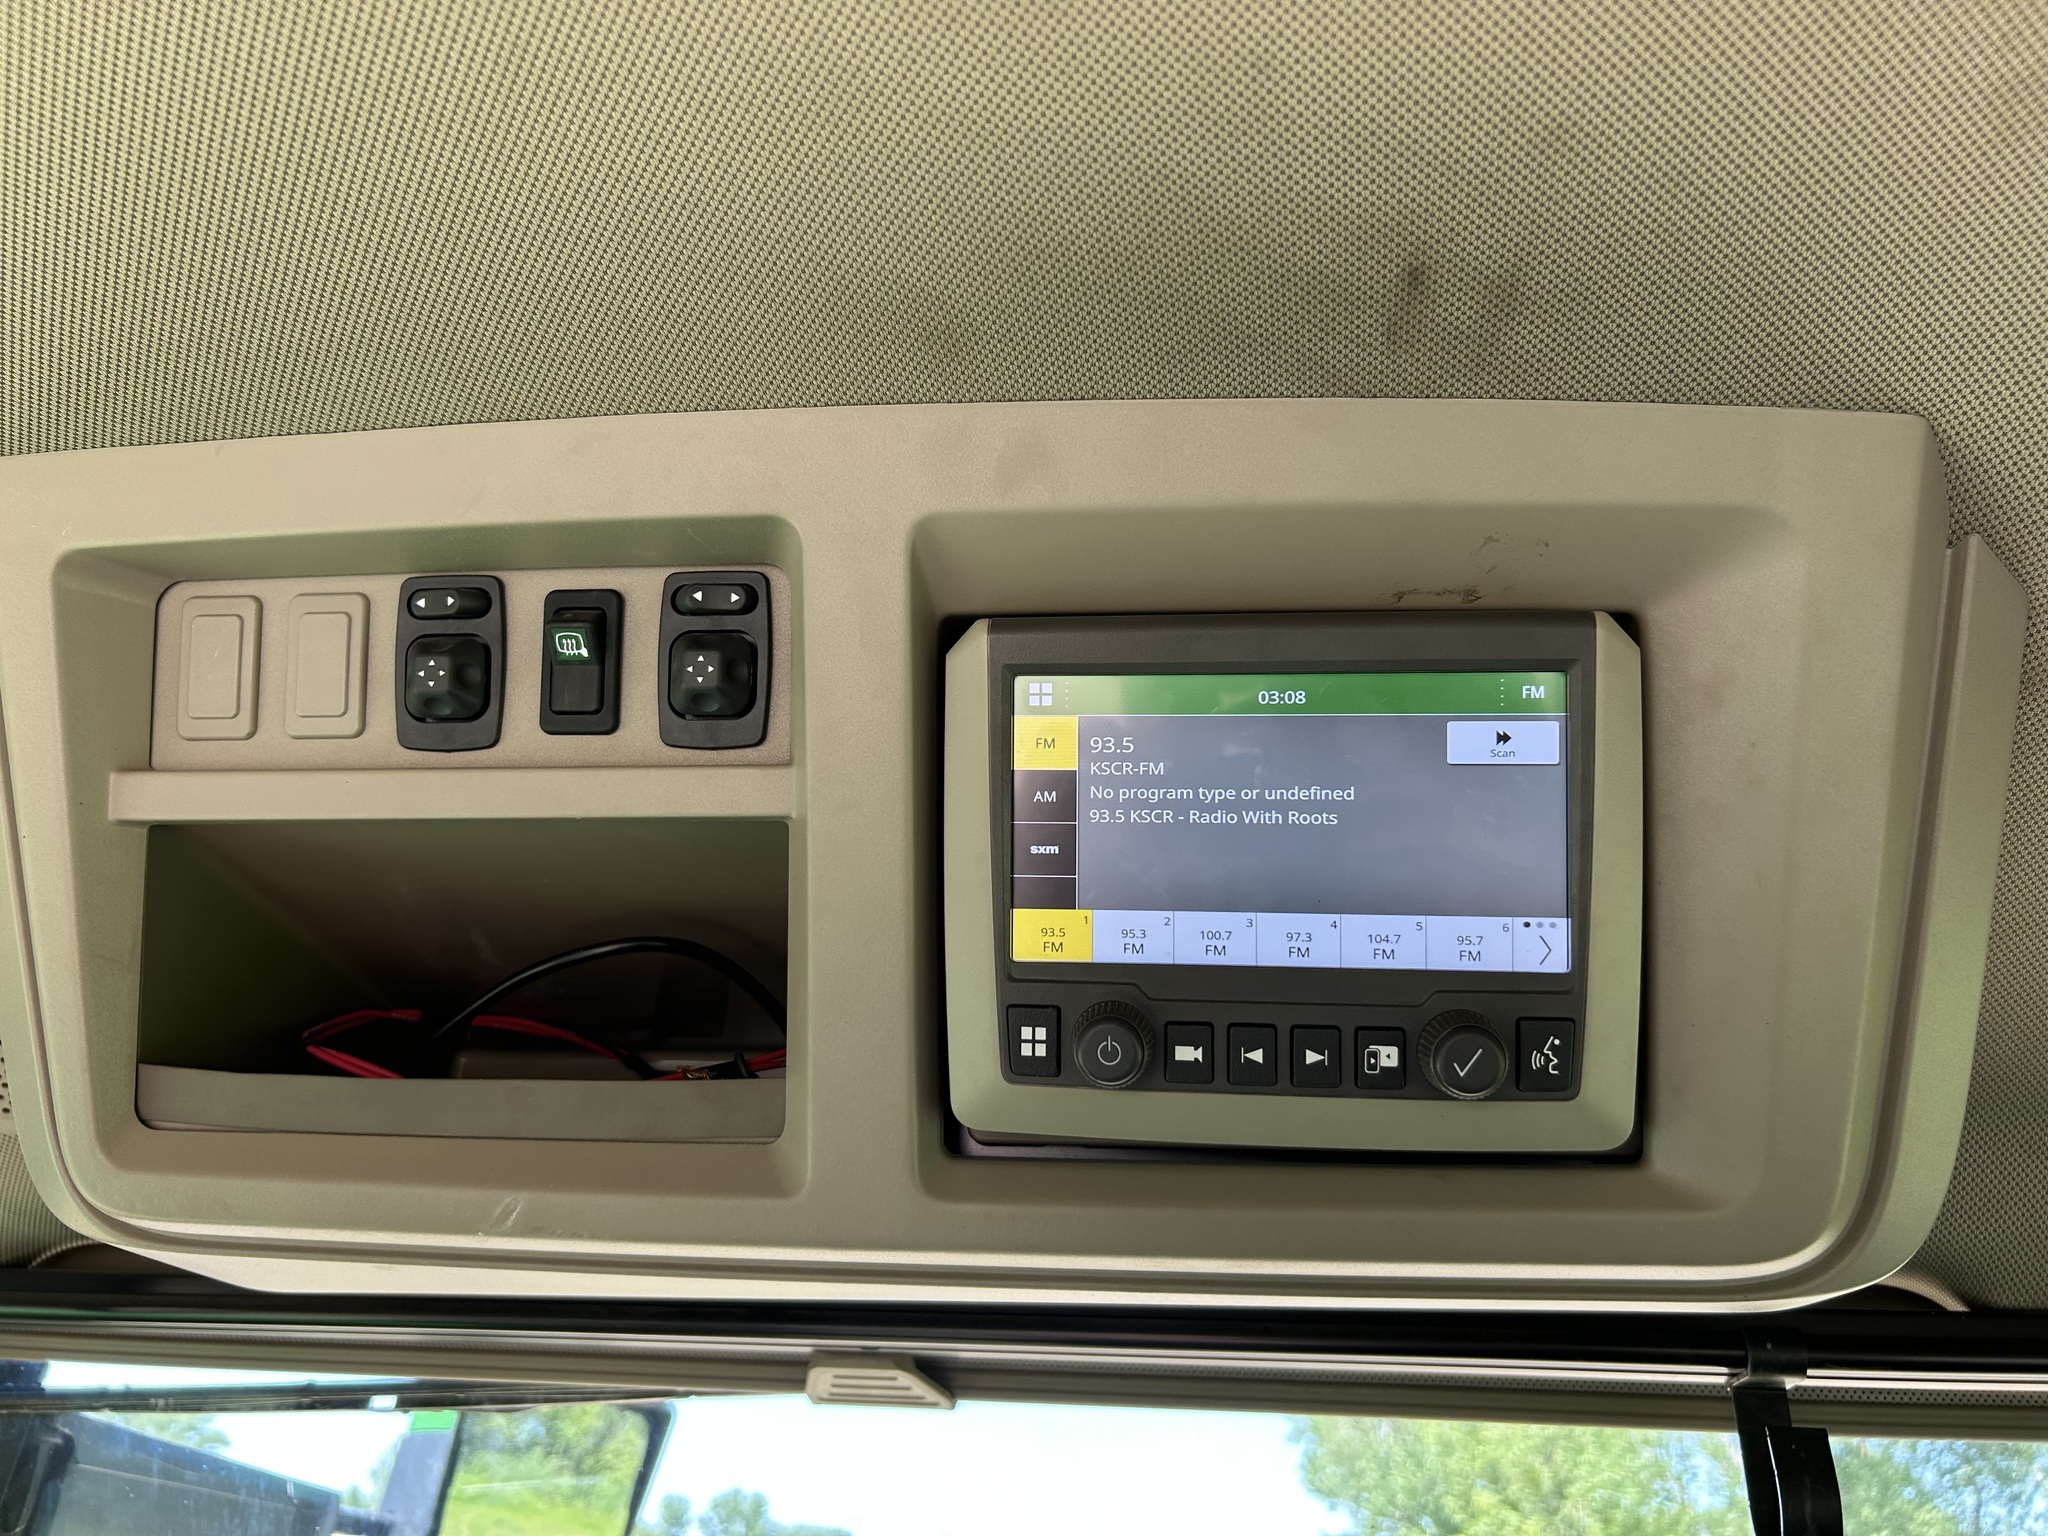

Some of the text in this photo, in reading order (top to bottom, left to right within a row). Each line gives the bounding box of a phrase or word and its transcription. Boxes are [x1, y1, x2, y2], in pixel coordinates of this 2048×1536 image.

[1522, 686, 1544, 698] FM
[1258, 690, 1306, 705] 03:08
[1036, 738, 1056, 749] FM
[1090, 737, 1134, 753] 93.5
[1490, 749, 1516, 758] Scan
[1090, 762, 1164, 775] KSCR-FM
[1034, 791, 1056, 802] AM
[1090, 786, 1354, 803] No program type or undefined
[1090, 810, 1124, 823] 93.5
[1130, 810, 1173, 823] KSCR
[1190, 810, 1237, 824] Radio
[1243, 810, 1282, 824] With
[1288, 810, 1338, 824] Roots
[1030, 844, 1059, 854] sxm
[1084, 916, 1088, 924] 1
[1164, 917, 1170, 926] 2
[1246, 918, 1253, 928] 3
[1330, 920, 1338, 929] 4
[1416, 922, 1422, 930] 5
[1502, 923, 1509, 932] 6
[1041, 928, 1066, 937] 93.5
[1121, 929, 1146, 938] 95.3
[1200, 930, 1232, 940] 100.7
[1286, 932, 1312, 942] 97.3
[1367, 934, 1401, 944] 104.7
[1456, 935, 1483, 945] 95.7
[1043, 942, 1064, 952] FM
[1123, 943, 1144, 954] FM
[1205, 944, 1226, 956] FM
[1288, 947, 1310, 958] FM
[1373, 948, 1395, 960] FM
[1459, 950, 1481, 962] FM
